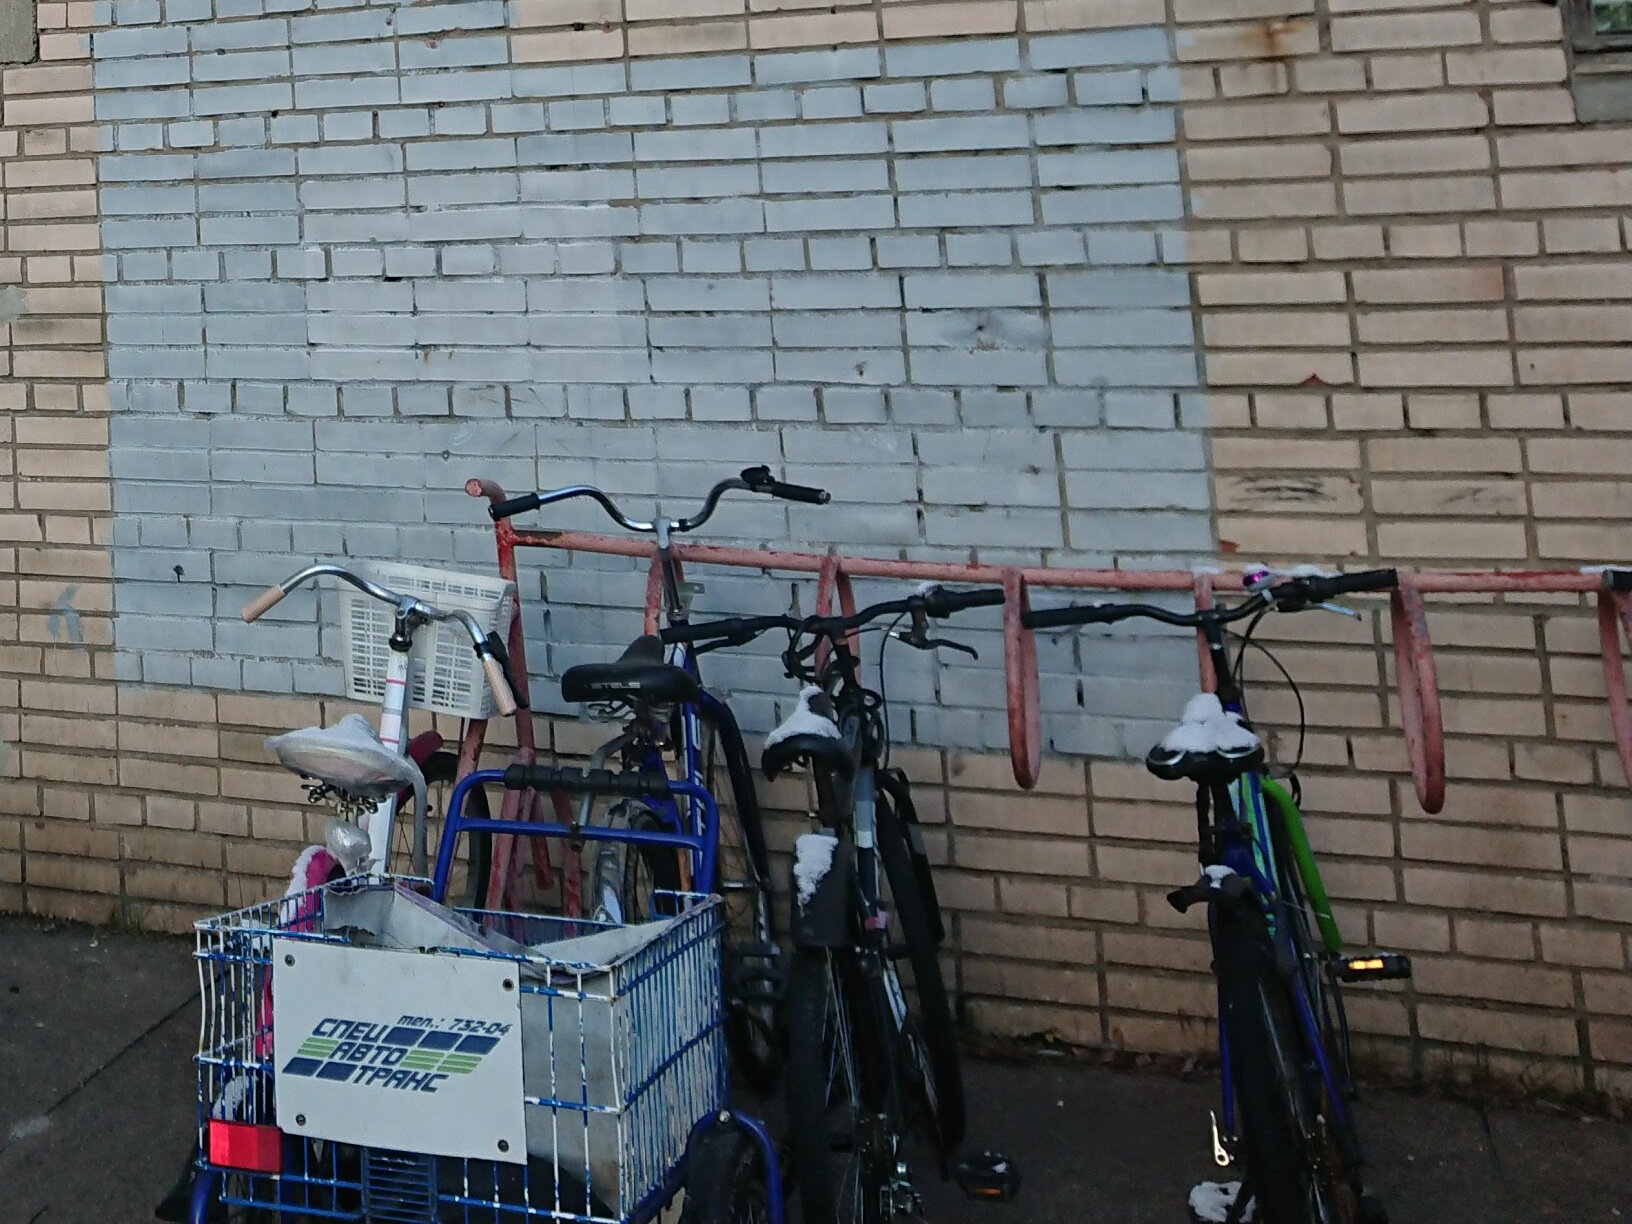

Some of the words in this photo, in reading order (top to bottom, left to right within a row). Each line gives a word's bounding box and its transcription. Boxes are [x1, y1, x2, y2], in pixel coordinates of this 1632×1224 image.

[312, 1018, 389, 1043] СПЕЦ
[328, 1041, 409, 1067] АВТО
[352, 1064, 450, 1093] ТРАНС
